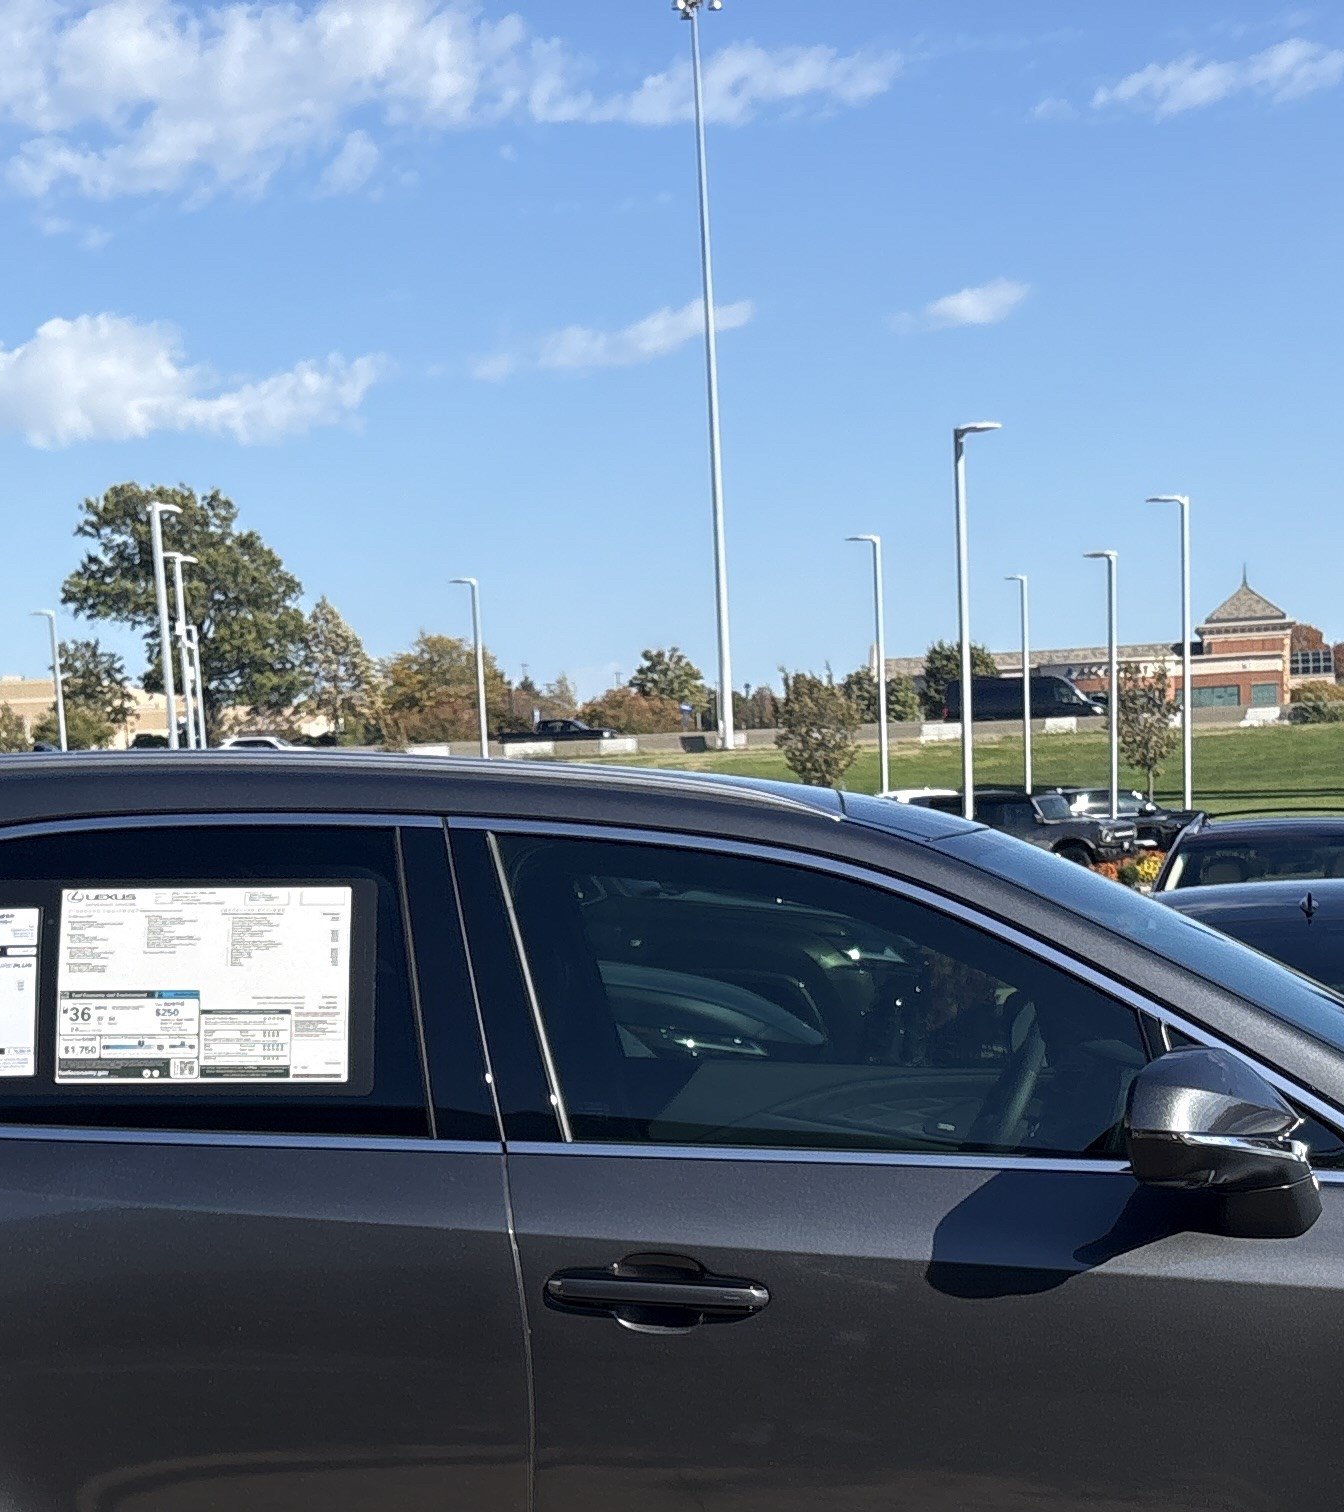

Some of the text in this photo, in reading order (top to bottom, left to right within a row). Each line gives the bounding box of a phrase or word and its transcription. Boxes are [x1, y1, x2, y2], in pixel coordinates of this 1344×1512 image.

[85, 893, 136, 901] LEXUS
[69, 1006, 92, 1022] 36
[155, 1008, 179, 1017] $250
